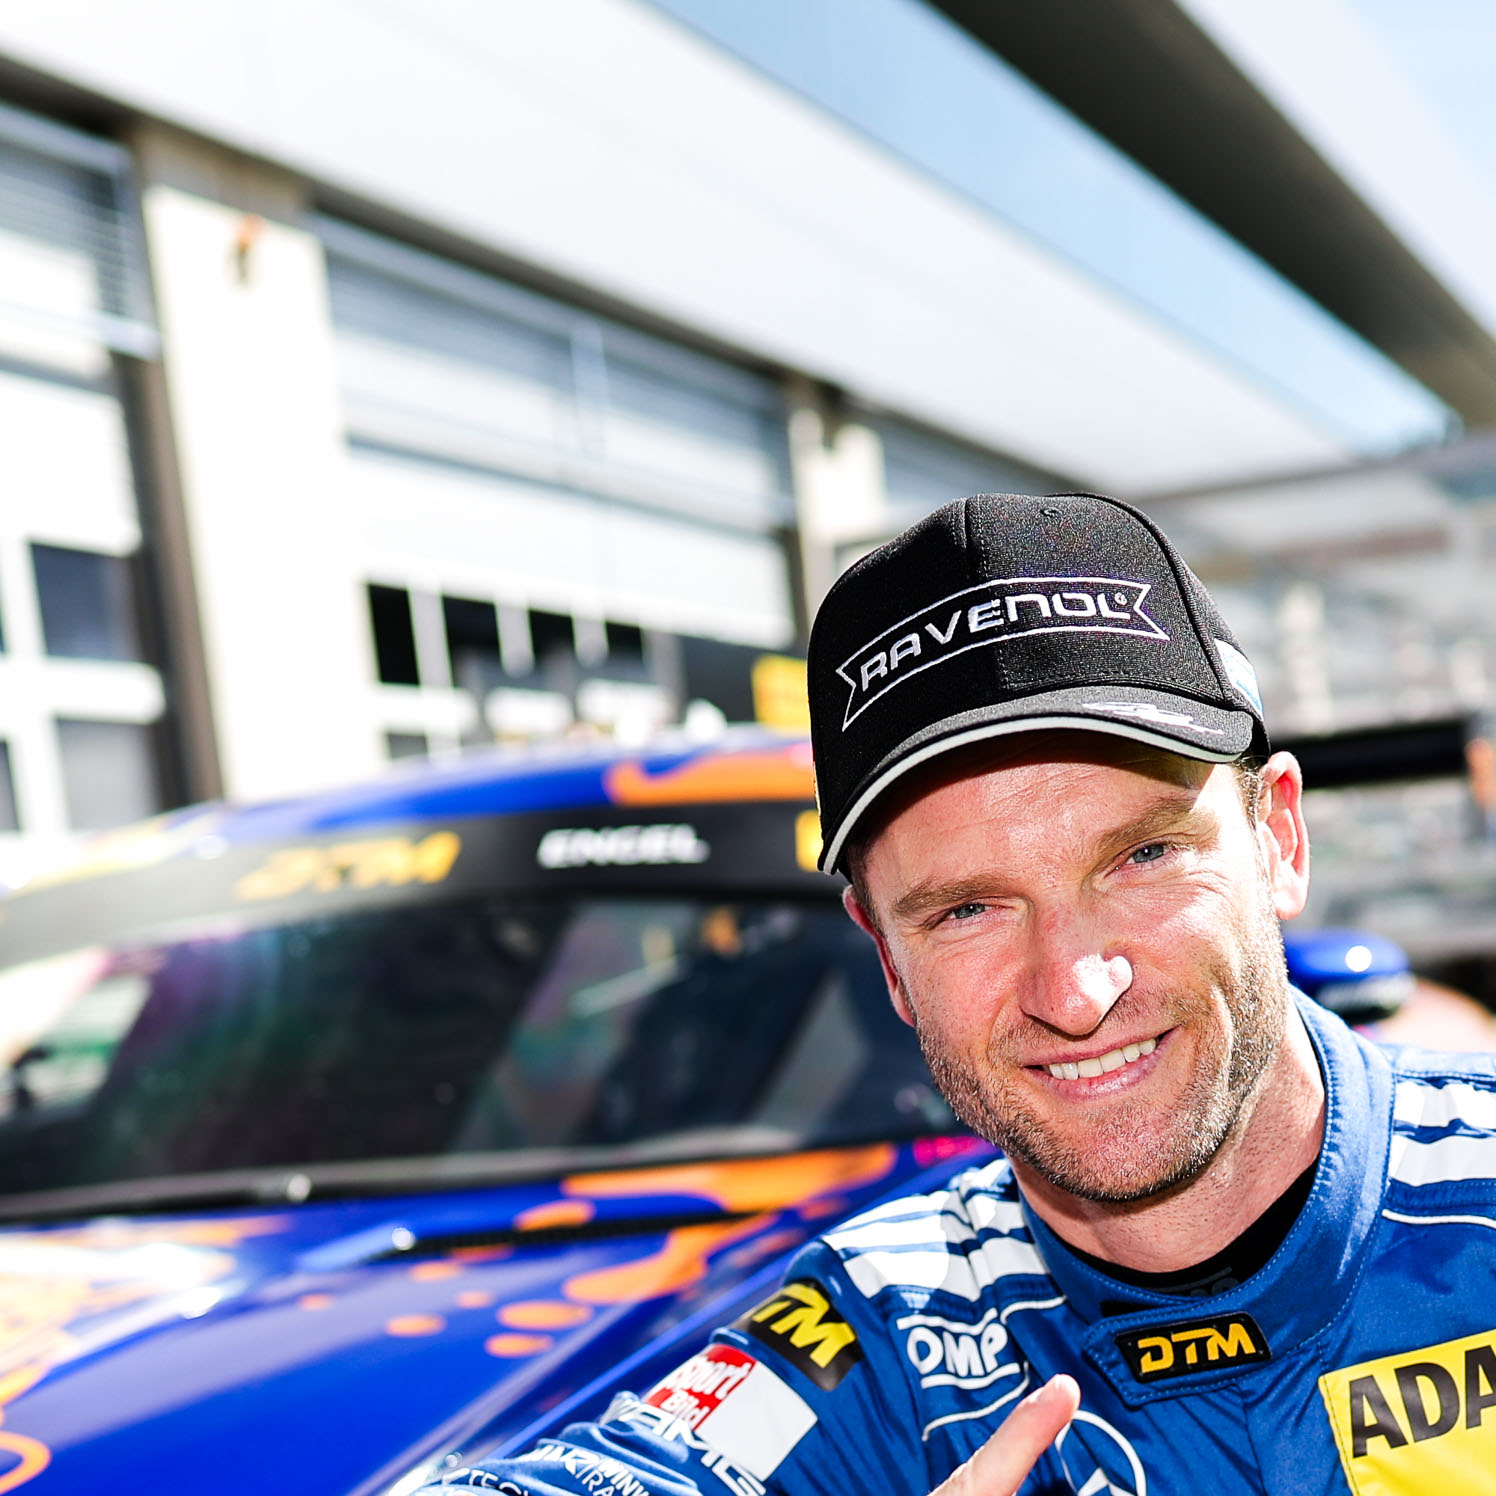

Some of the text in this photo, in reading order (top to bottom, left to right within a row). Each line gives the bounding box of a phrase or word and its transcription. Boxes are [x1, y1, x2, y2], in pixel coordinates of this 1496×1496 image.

[860, 592, 1132, 693] RAVENOL
[537, 825, 709, 869] ENGEL
[906, 1323, 1008, 1377] OMP
[1137, 1322, 1256, 1376] DTM
